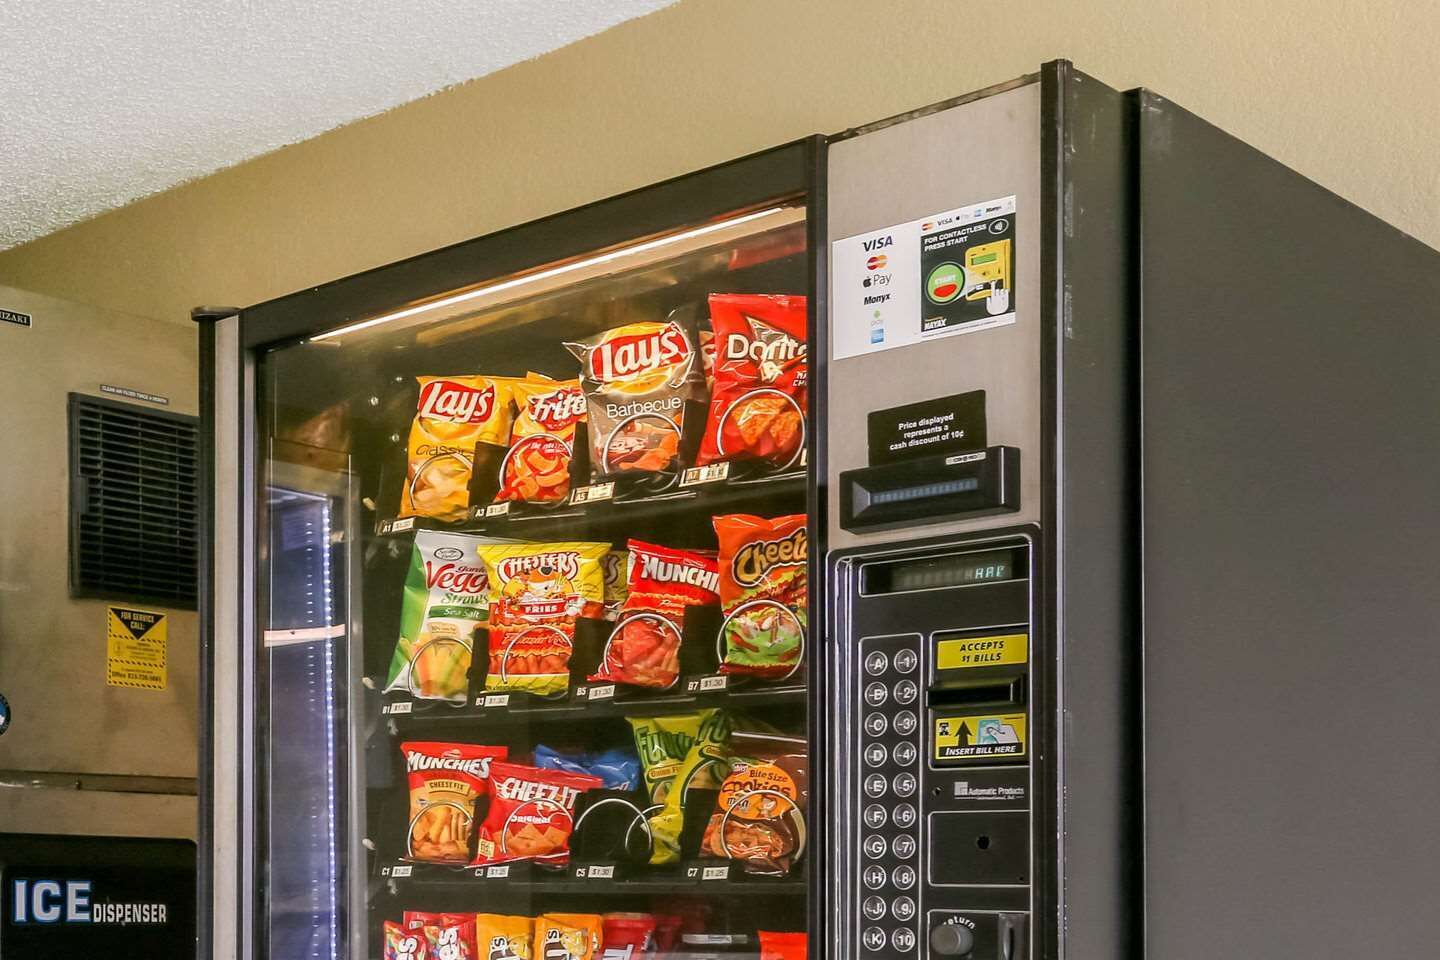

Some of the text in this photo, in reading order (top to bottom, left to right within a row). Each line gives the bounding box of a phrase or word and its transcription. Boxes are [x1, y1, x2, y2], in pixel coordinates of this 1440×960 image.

[925, 224, 987, 244] FOR CONTACTLESS
[863, 235, 893, 252] VISA
[925, 236, 969, 252] PRESS START
[873, 274, 892, 286] Pay
[864, 293, 890, 305] Monyx
[602, 330, 679, 382] Lay's
[421, 383, 492, 423] Lay's
[527, 391, 587, 423] Frito
[606, 398, 681, 419] Barbecue
[898, 413, 954, 431] Price displayed
[903, 426, 943, 439] represents
[889, 442, 907, 450] cash
[908, 435, 941, 447] discount
[575, 491, 586, 502] A5
[475, 507, 485, 518] A3
[383, 523, 393, 534] A1
[497, 551, 580, 584] CHESTER'S
[426, 561, 490, 593] Vegg
[641, 554, 720, 595] MUNCHI
[463, 609, 480, 618] Salt
[525, 605, 558, 613] FRIES
[960, 641, 1004, 652] ACCEPTS
[905, 657, 910, 667] 1
[962, 653, 1001, 663] $1 BILLS
[874, 659, 882, 669] A
[688, 681, 699, 691] B7
[874, 689, 882, 699] B
[904, 687, 910, 698] 2
[874, 719, 882, 731] C
[903, 718, 910, 729] 3
[874, 750, 882, 761] D
[903, 749, 910, 760] 4
[945, 745, 1017, 756] INSERT BILL HERE
[408, 751, 492, 778] MUNCHIES
[768, 773, 788, 782] Size
[429, 782, 452, 790] CHEESE
[874, 781, 882, 792] E
[903, 780, 910, 791] 5
[969, 786, 1024, 795] Automatic Products
[874, 812, 881, 822] F
[903, 811, 910, 822] 6
[872, 842, 882, 853] G
[903, 842, 910, 853] 7
[576, 867, 586, 877] C5
[687, 867, 698, 878] C7
[872, 872, 881, 883] H
[902, 873, 909, 884] 8
[14, 880, 167, 923] ICE DISPENSER
[873, 904, 880, 914] J
[902, 904, 909, 915] 9
[944, 916, 975, 929] eturn
[872, 934, 881, 945] K
[898, 935, 910, 946] 10
